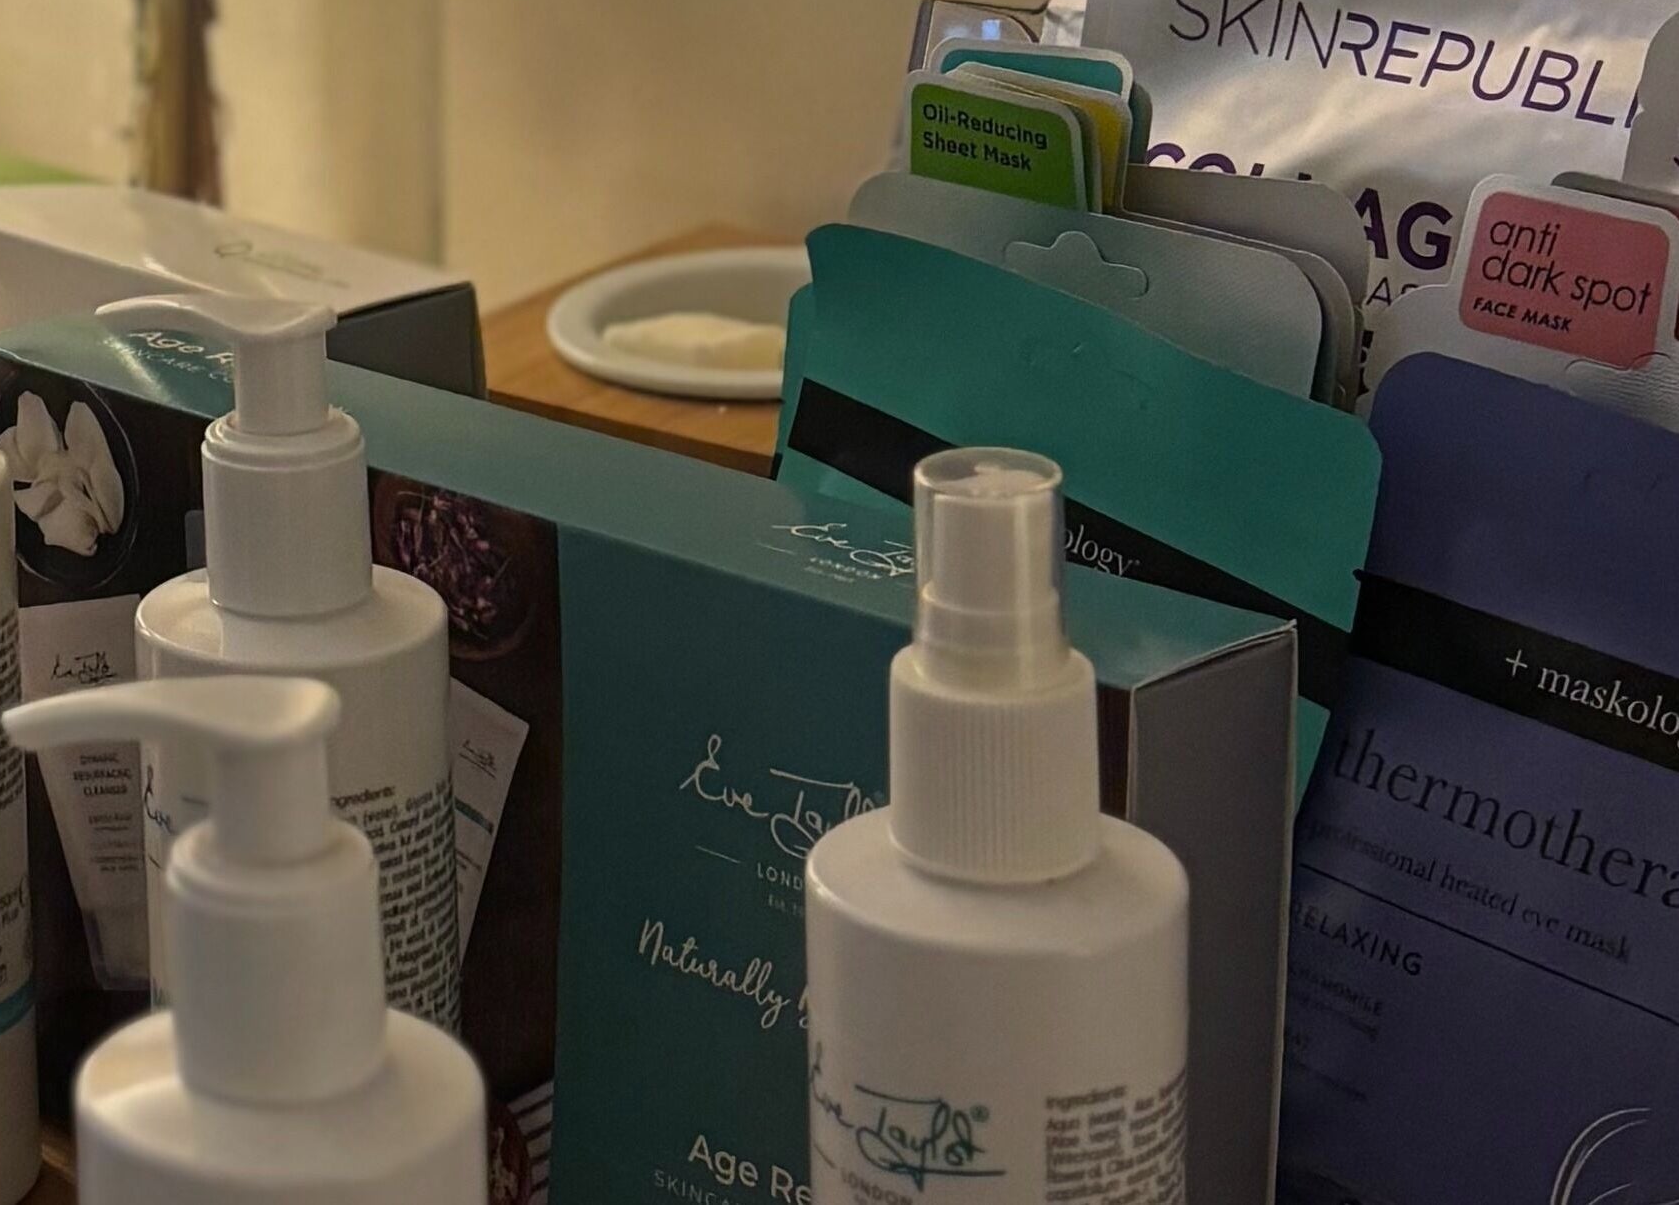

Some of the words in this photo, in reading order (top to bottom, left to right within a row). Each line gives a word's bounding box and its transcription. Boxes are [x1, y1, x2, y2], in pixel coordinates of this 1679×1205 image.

[923, 103, 1048, 150] Oil-Reducing
[923, 131, 979, 159] Sheet
[984, 143, 1032, 172] Mask
[1490, 220, 1561, 257] anti
[1482, 250, 1565, 296] dark
[1571, 275, 1652, 316] spot
[1473, 297, 1518, 319] FACE
[1522, 308, 1573, 332] MASK
[1537, 664, 1679, 750] maskolo
[679, 734, 769, 818] Eve
[757, 862, 804, 891] LOND
[638, 917, 791, 1029] Naturally
[688, 1134, 759, 1187] Age
